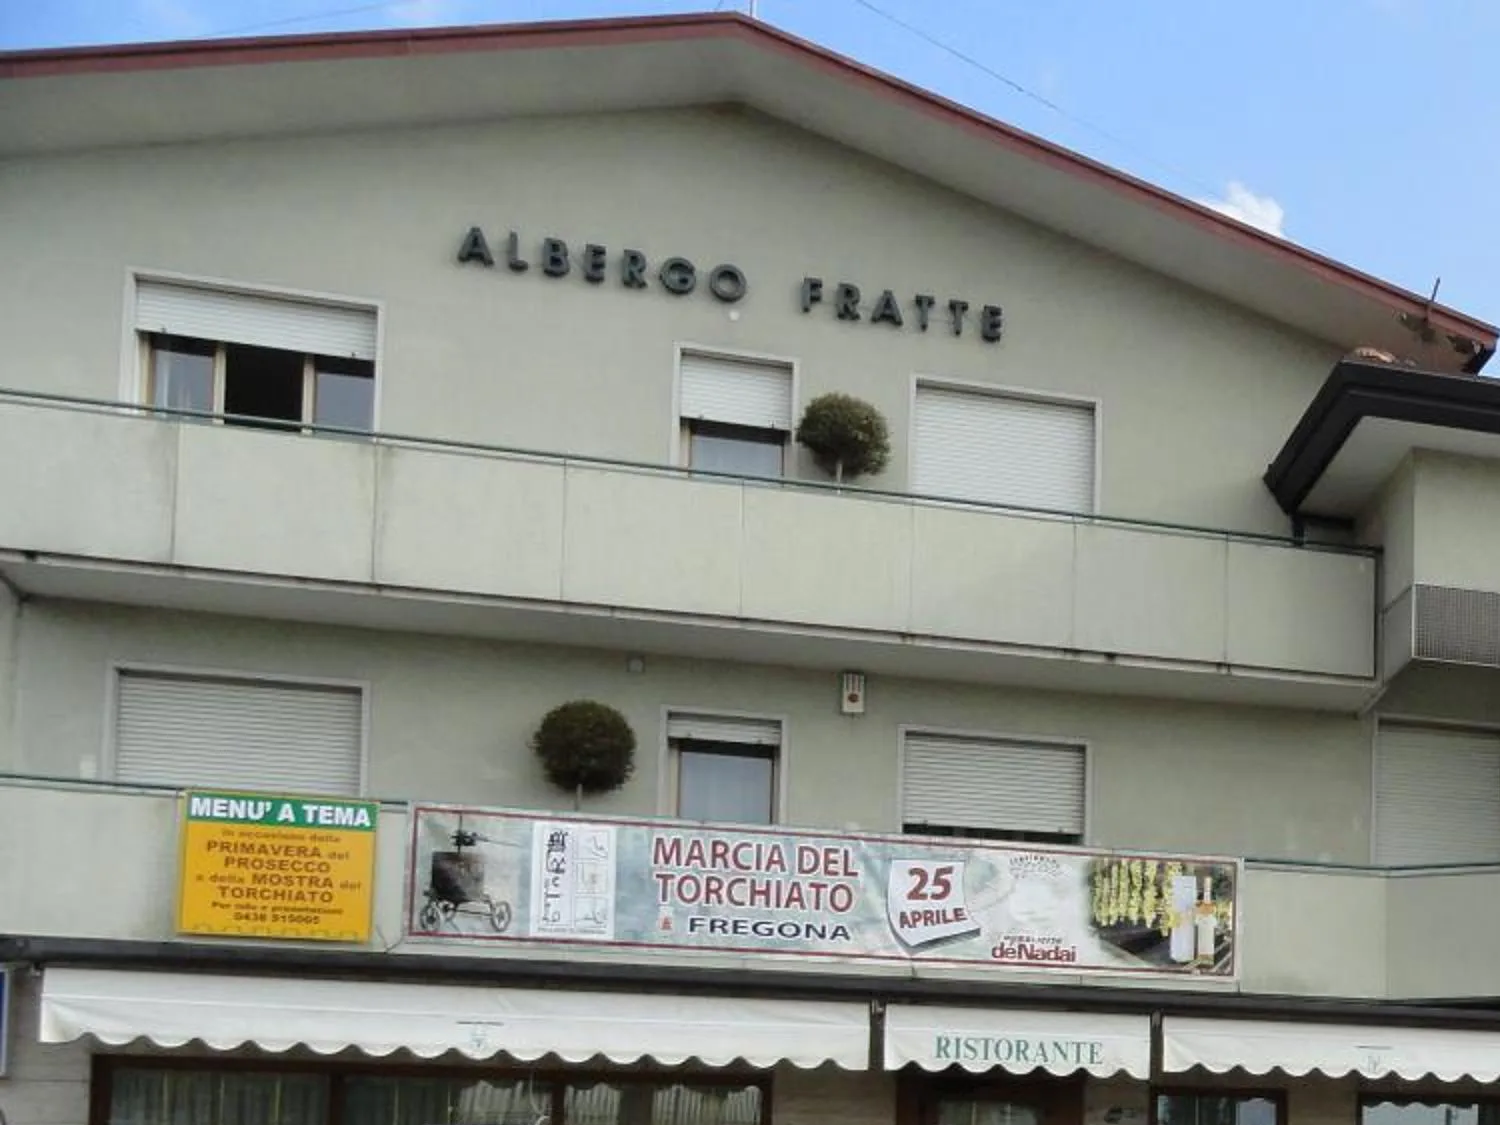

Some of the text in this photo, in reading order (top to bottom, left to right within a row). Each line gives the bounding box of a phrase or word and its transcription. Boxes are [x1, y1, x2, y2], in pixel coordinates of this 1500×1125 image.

[457, 226, 1003, 342] ALBERGO FRATTE
[190, 797, 372, 828] MENU' A TEMA
[206, 840, 322, 859] PRIMAVERA
[653, 837, 858, 877] MARCIA DEL
[223, 855, 331, 873] PROSECCO
[251, 873, 334, 889] MOSTRA
[655, 873, 854, 912] TORCHIATO
[906, 867, 953, 900] 25
[217, 885, 334, 904] TORCHIATO
[688, 917, 851, 941] FREGONA
[899, 908, 968, 929] APRILE
[935, 1036, 1104, 1065] RISTORANTE
